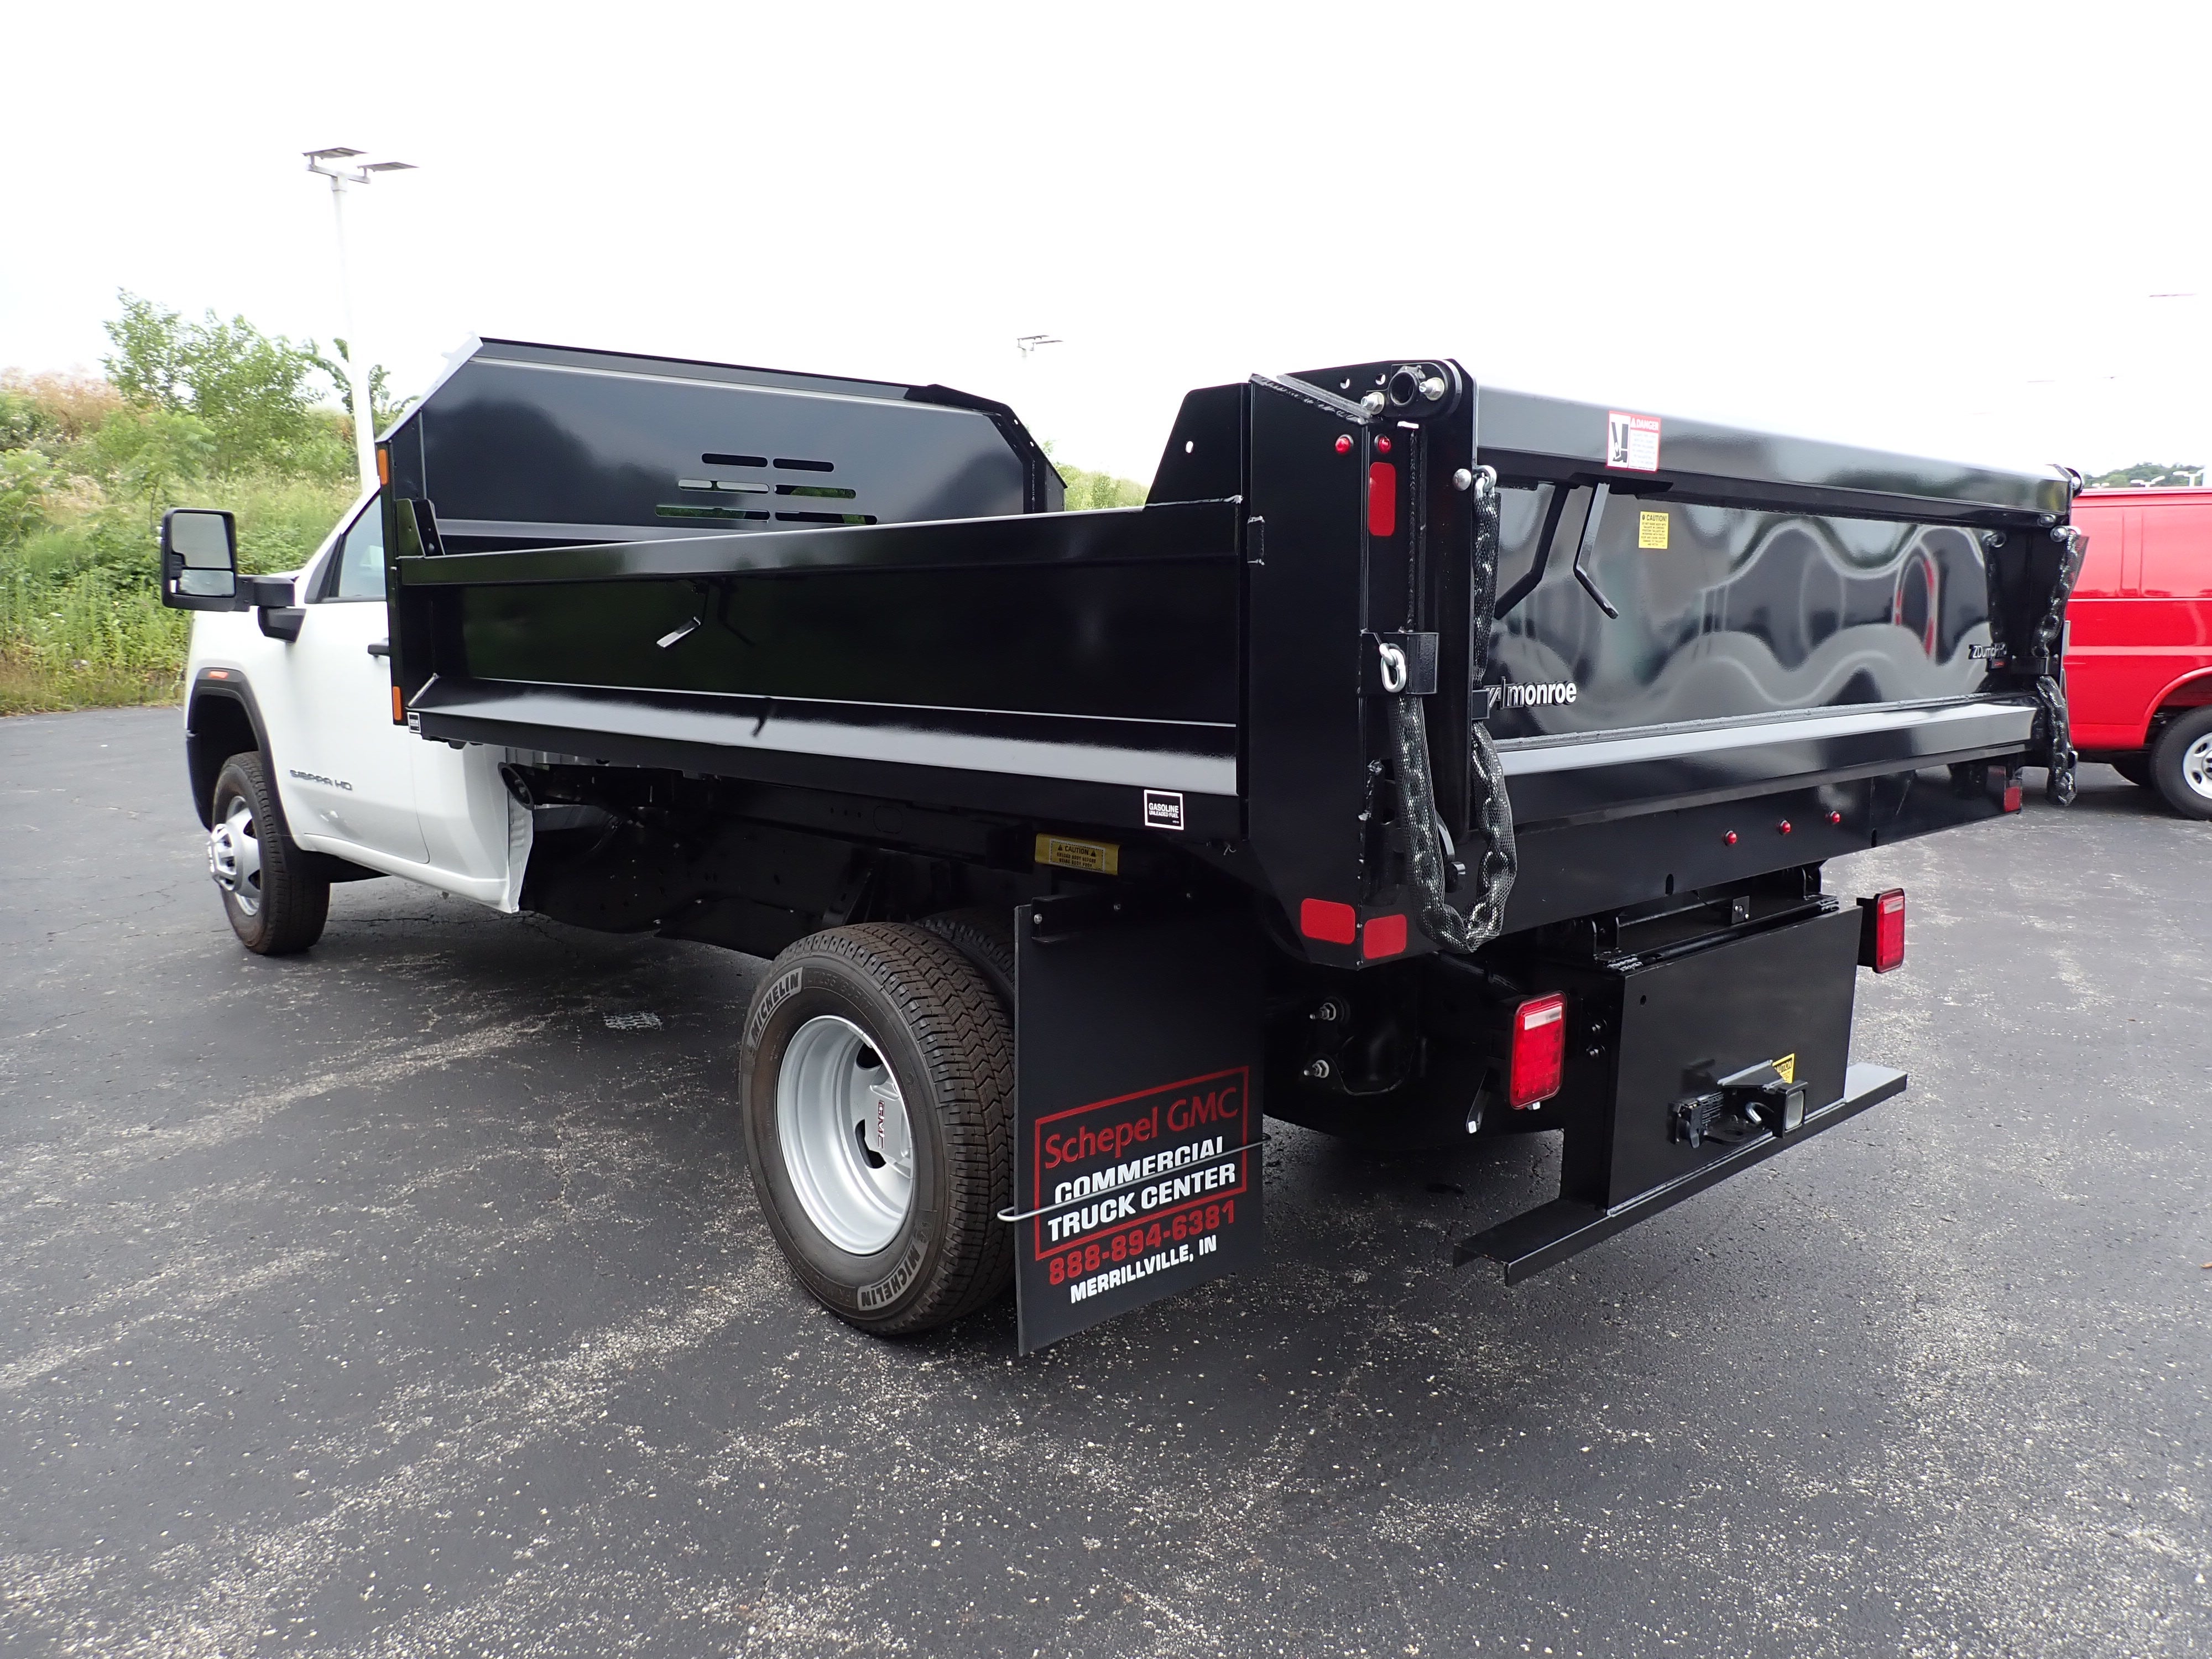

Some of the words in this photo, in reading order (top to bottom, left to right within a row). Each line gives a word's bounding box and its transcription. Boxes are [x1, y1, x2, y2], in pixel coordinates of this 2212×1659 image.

[335, 780, 352, 791] HD
[1149, 802, 1179, 813] GASOLINE
[1065, 846, 1089, 855] CAUTION
[751, 972, 799, 1044] MICHELIN
[1045, 1107, 1159, 1169] Schepel
[1167, 1087, 1238, 1131] GMC
[1047, 1192, 1136, 1241] TRUCK
[1141, 1163, 1236, 1209] CENTER
[861, 1244, 921, 1306] MICHELIN
[1049, 1199, 1235, 1285] 888-894-6381
[1071, 1244, 1194, 1304] MERRILLVILLE,
[1199, 1235, 1217, 1256] IN
